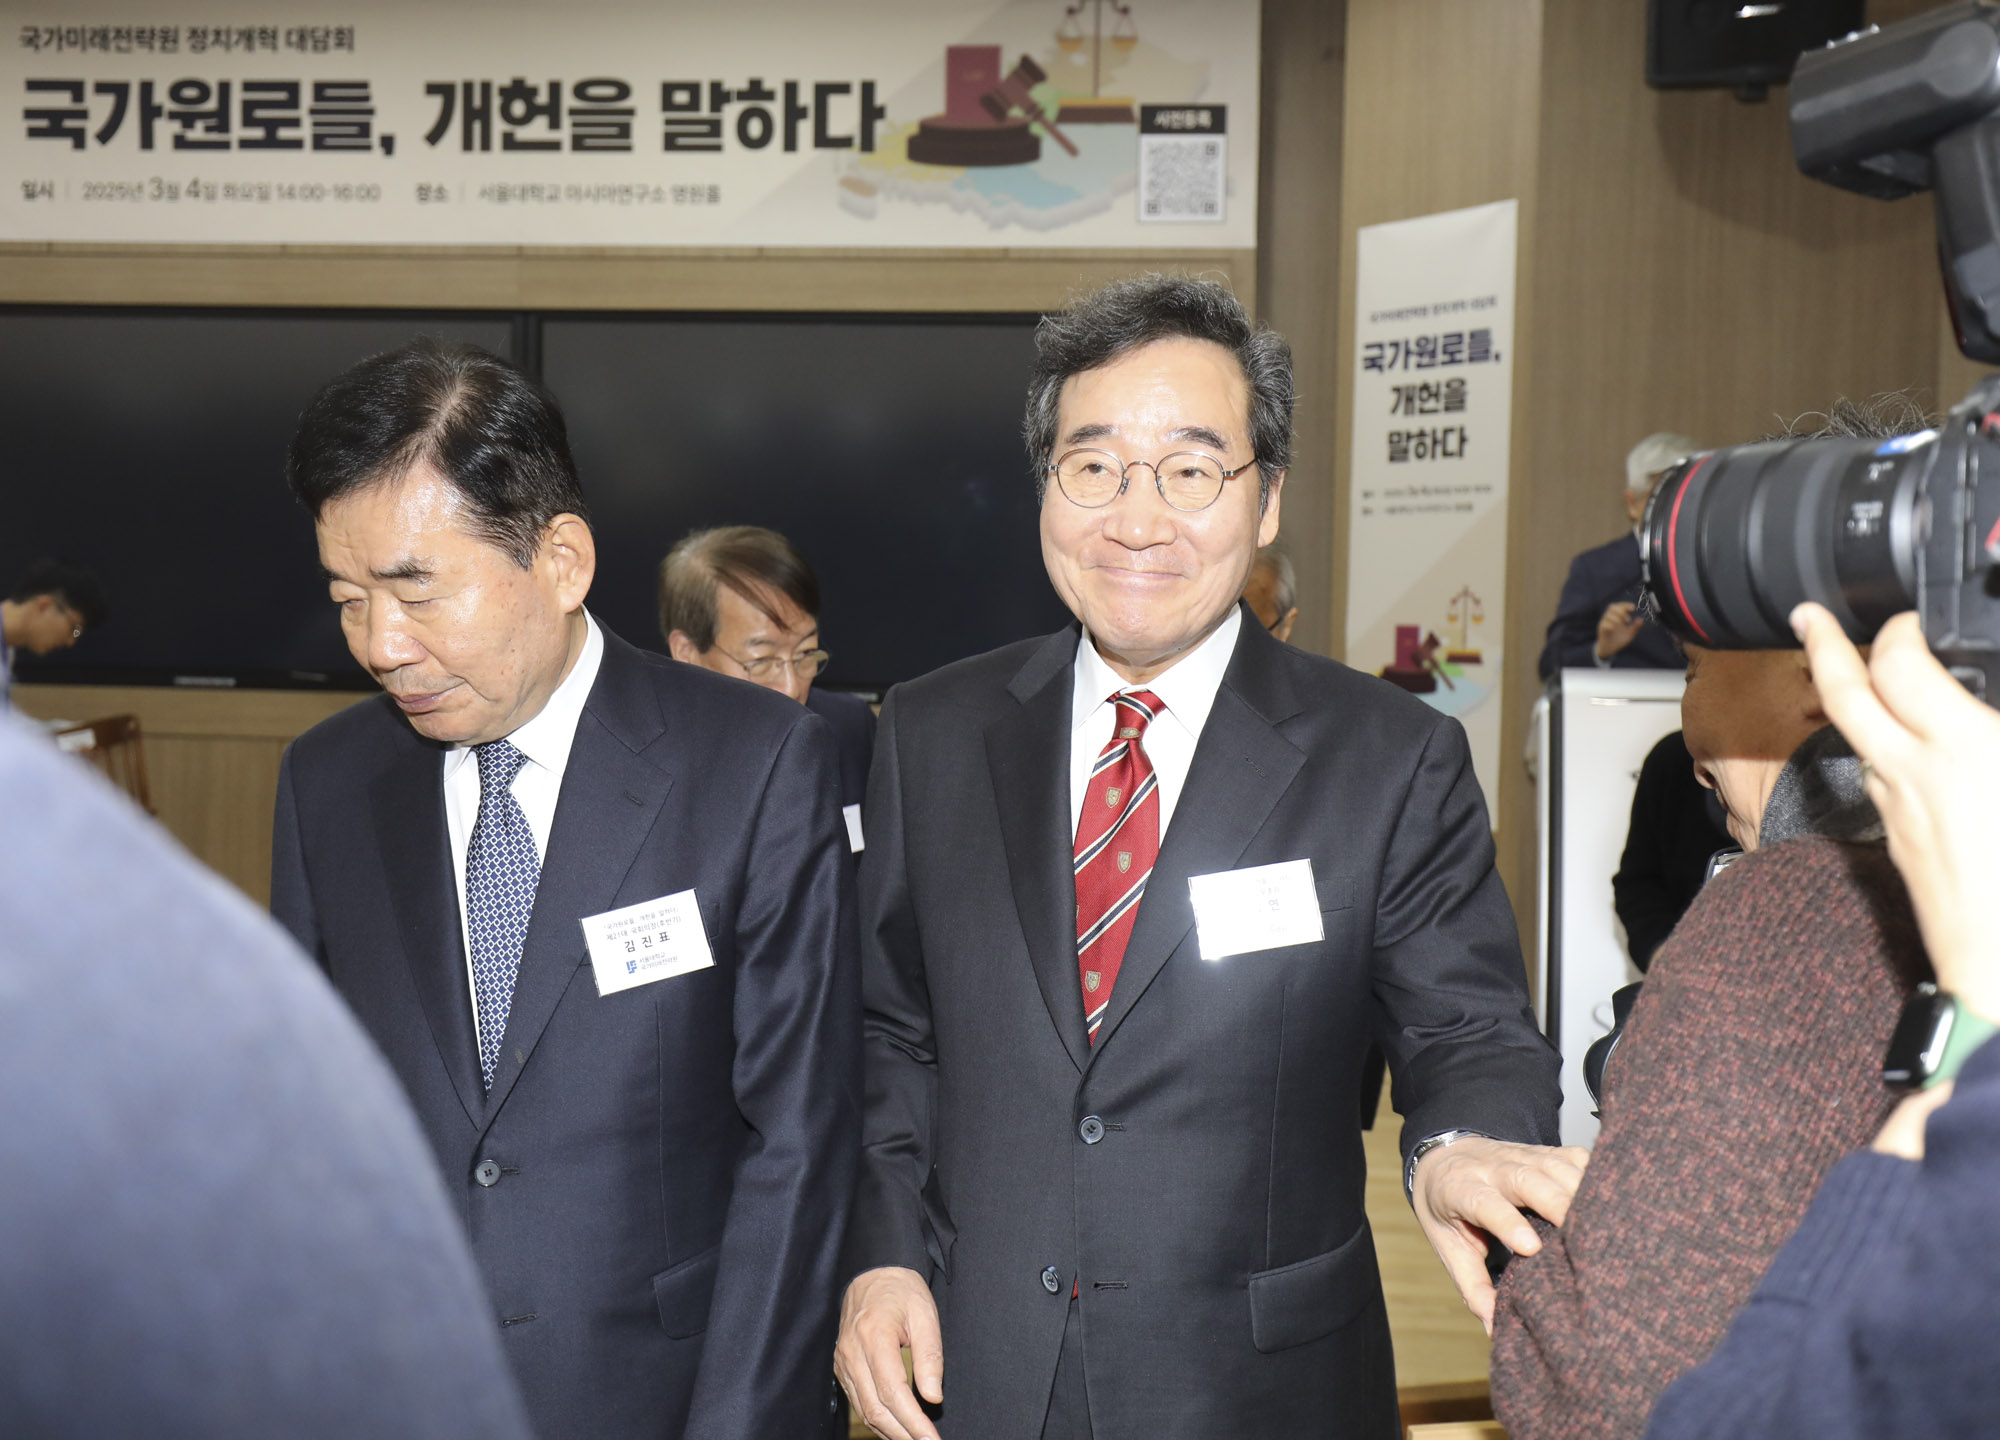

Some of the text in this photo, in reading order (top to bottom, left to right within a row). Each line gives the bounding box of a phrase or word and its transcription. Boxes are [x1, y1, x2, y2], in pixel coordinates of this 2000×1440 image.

[20, 26, 354, 53] 국가미래전략원 정치개혁 대담회
[22, 77, 887, 157] 국가원로들, 개헌을 말하다
[1363, 328, 1501, 374] 국가원로들,
[1391, 377, 1467, 416] 개헌을
[1388, 426, 1468, 463] 말하다
